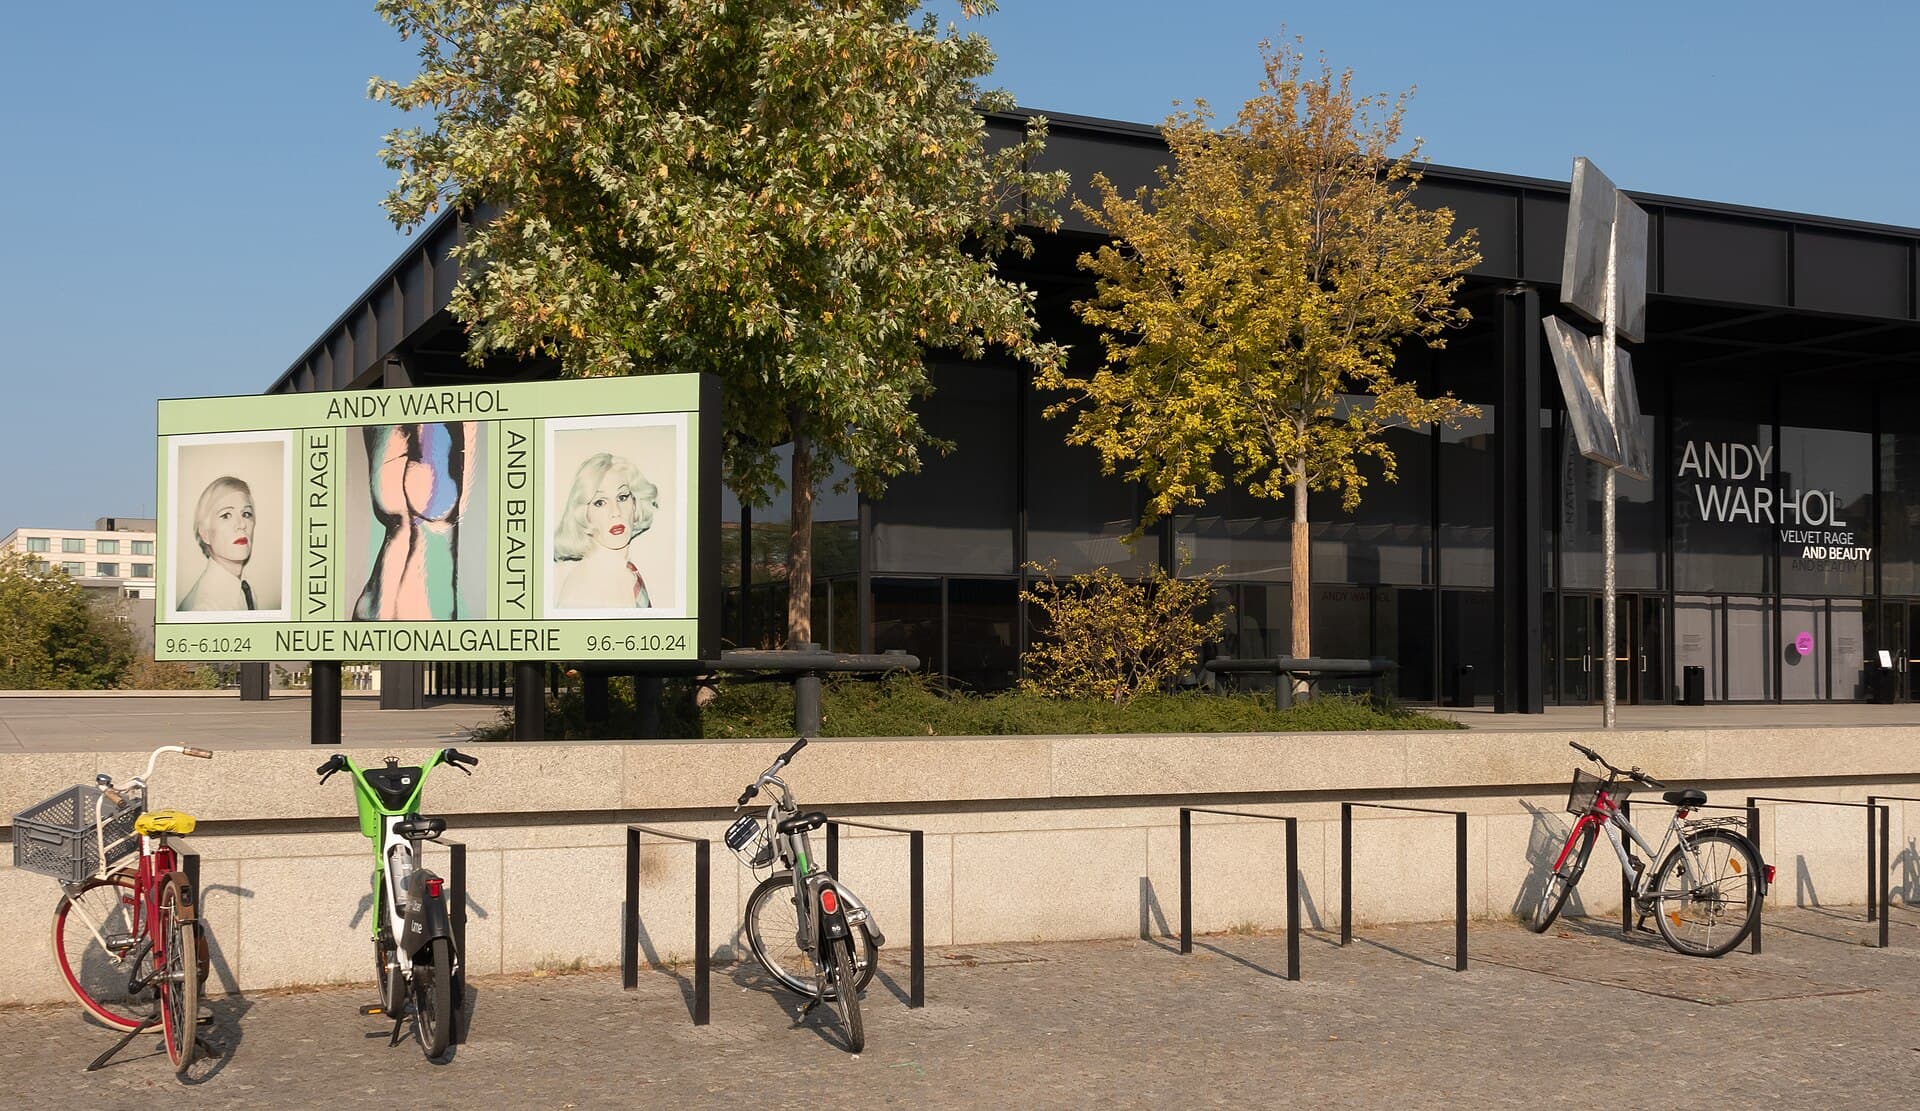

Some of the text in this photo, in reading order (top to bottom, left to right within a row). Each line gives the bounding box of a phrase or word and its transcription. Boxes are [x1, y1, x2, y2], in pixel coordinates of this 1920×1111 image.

[326, 389, 509, 420] ANDY WARHOL
[1678, 440, 1774, 481] ANDY
[506, 430, 527, 610] AND BEAUTY
[1695, 484, 1847, 527] WARHOL
[308, 433, 329, 615] VELVET RAGE
[1780, 530, 1855, 545] VELVET RAGE
[1802, 546, 1872, 561] AND BEAUTY
[275, 628, 561, 652] NEUE NATIONALGALERIE
